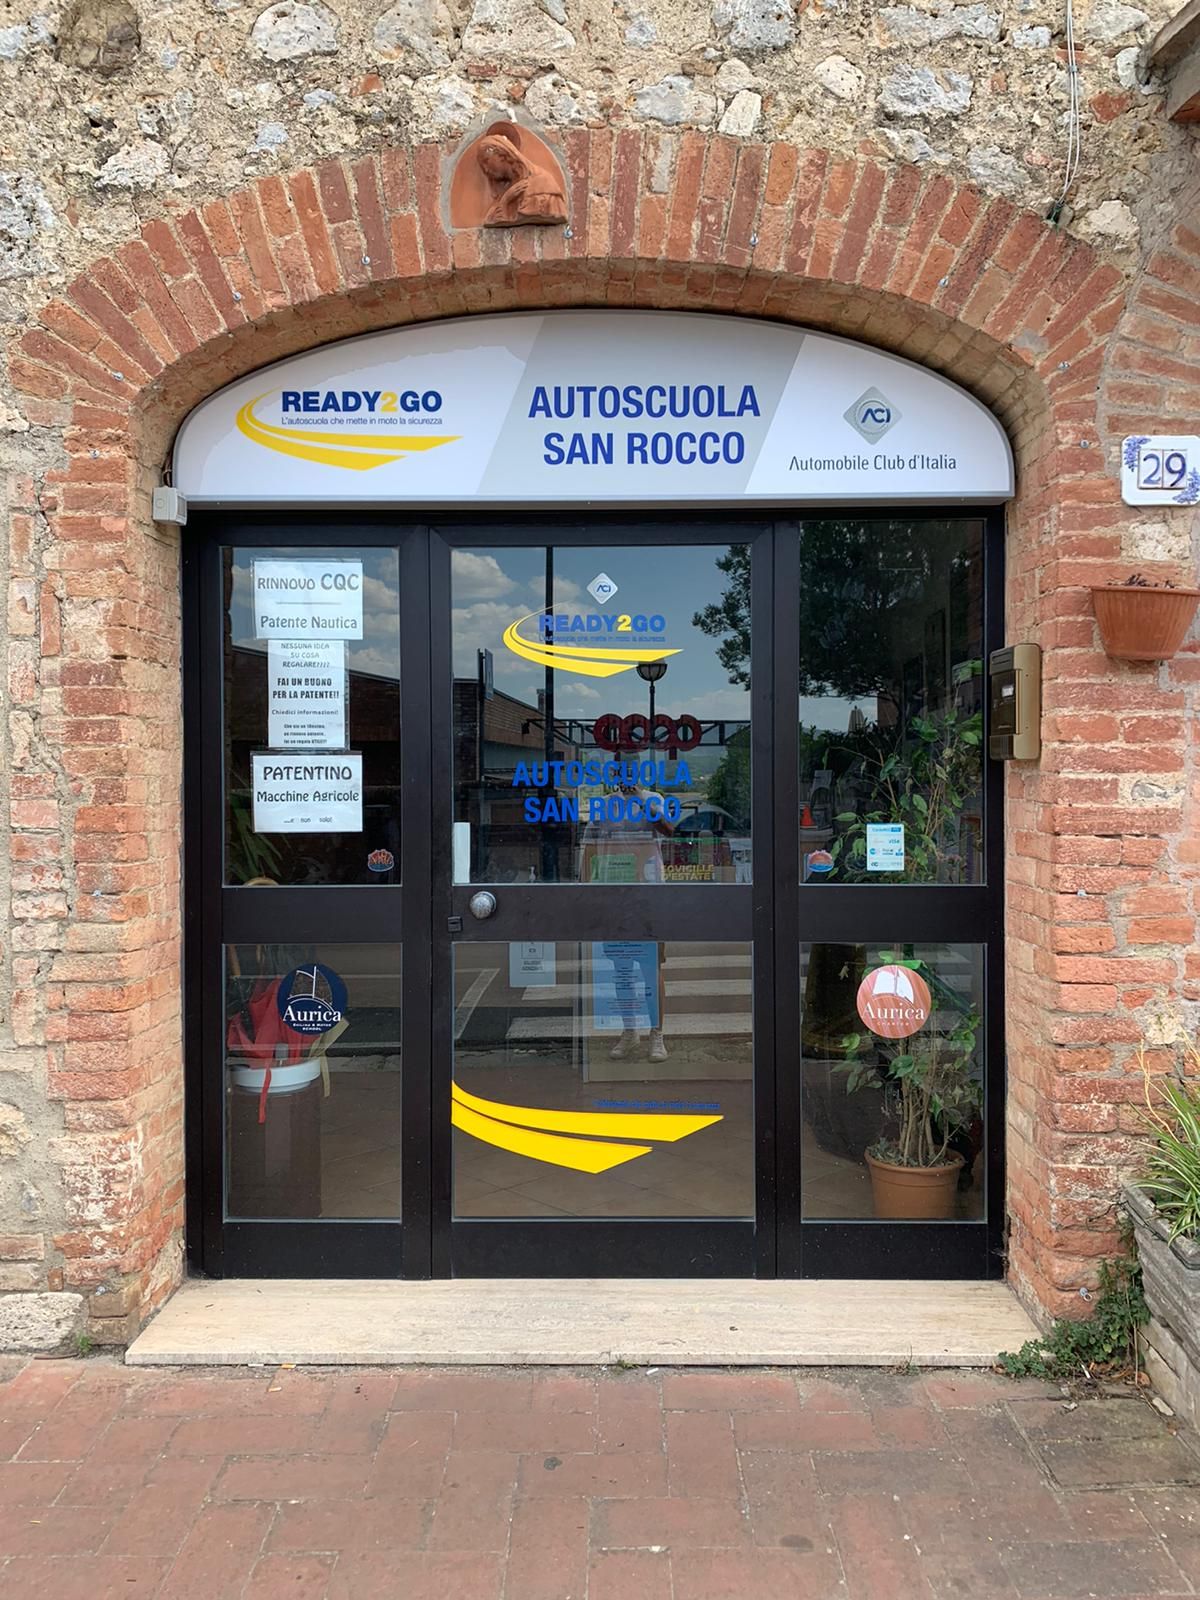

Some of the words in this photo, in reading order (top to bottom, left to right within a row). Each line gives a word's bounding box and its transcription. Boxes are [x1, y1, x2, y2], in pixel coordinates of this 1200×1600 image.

[281, 390, 443, 412] READY2GO
[528, 384, 761, 418] AUTOSCUOLA
[281, 416, 329, 425] L'autoscuola
[330, 416, 345, 425] che
[345, 416, 368, 425] mette
[369, 416, 377, 425] in
[377, 416, 398, 425] moto
[399, 416, 407, 425] la
[408, 416, 443, 425] sicurezza
[860, 407, 892, 424] ACI
[543, 431, 614, 465] SAN
[627, 431, 746, 465] ROCCO
[789, 455, 869, 471] Automobile
[873, 454, 905, 470] Club
[908, 454, 957, 470] d'Italia
[1142, 452, 1187, 488] 29
[257, 577, 316, 590] RINNOVO
[320, 573, 360, 591] CQC
[260, 615, 308, 629] Patente
[311, 616, 358, 629] Nautica
[538, 614, 667, 633] READY2GO
[277, 678, 289, 686] FAI
[291, 678, 302, 686] UN
[304, 678, 332, 686] BUONO
[272, 690, 287, 699] PER
[289, 690, 298, 699] LA
[300, 690, 340, 699] PATENTE!!
[263, 766, 353, 780] PATENTINO
[512, 760, 693, 788] AUTOSCUOLA
[256, 790, 309, 802] Macchine
[312, 790, 360, 802] Agricole
[524, 796, 579, 823] SAN
[590, 796, 681, 823] ROCCO
[282, 1005, 341, 1021] Aurica
[861, 1002, 925, 1020] Aurica
